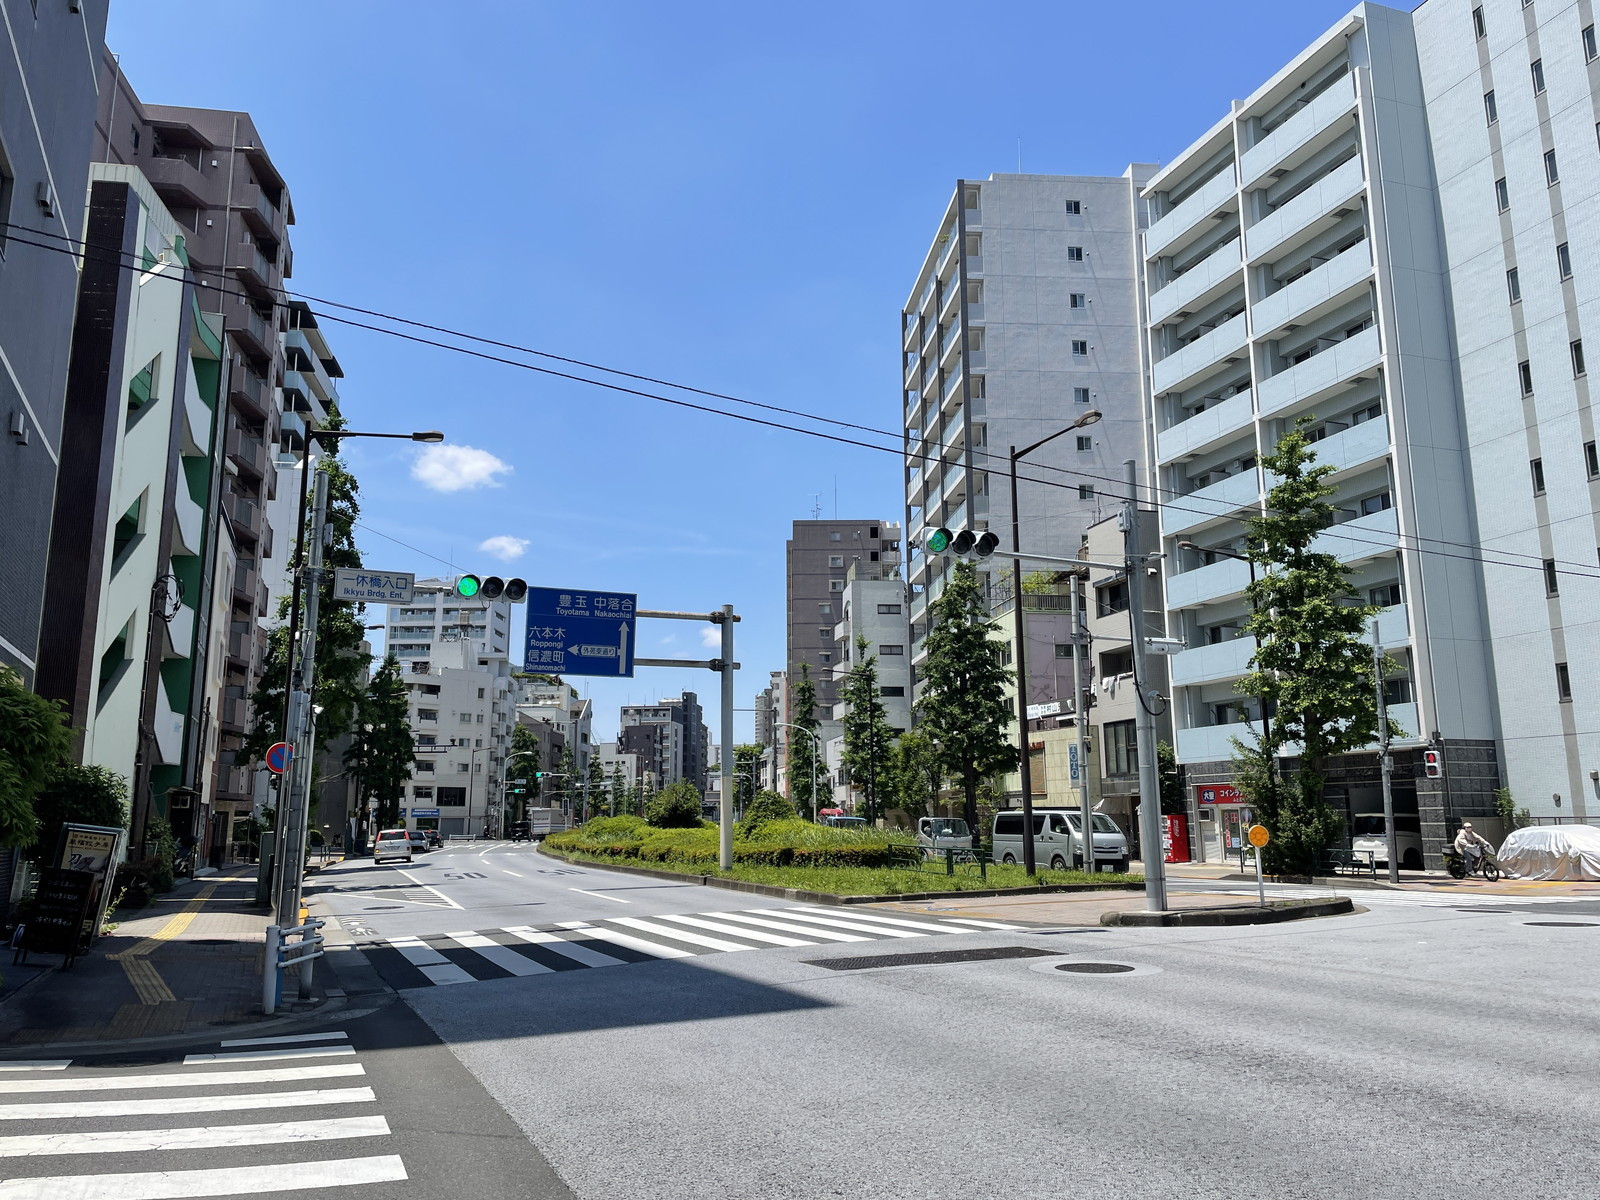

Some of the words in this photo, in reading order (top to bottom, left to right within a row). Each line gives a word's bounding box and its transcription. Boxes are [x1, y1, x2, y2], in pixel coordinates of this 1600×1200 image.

[342, 574, 408, 590] 一休橋入口
[343, 587, 365, 597] Ikkyu
[367, 589, 387, 599] Brdg.
[389, 591, 405, 599] Ent.
[594, 596, 634, 611] 中落合
[556, 607, 590, 617] Toyotama
[594, 609, 632, 619] Nakaochiai
[528, 625, 567, 640] 六本木
[530, 639, 564, 649] Roppongi
[527, 649, 565, 664] 信濃町
[525, 663, 566, 672] Shinanomachi
[1069, 744, 1079, 778] TOTO
